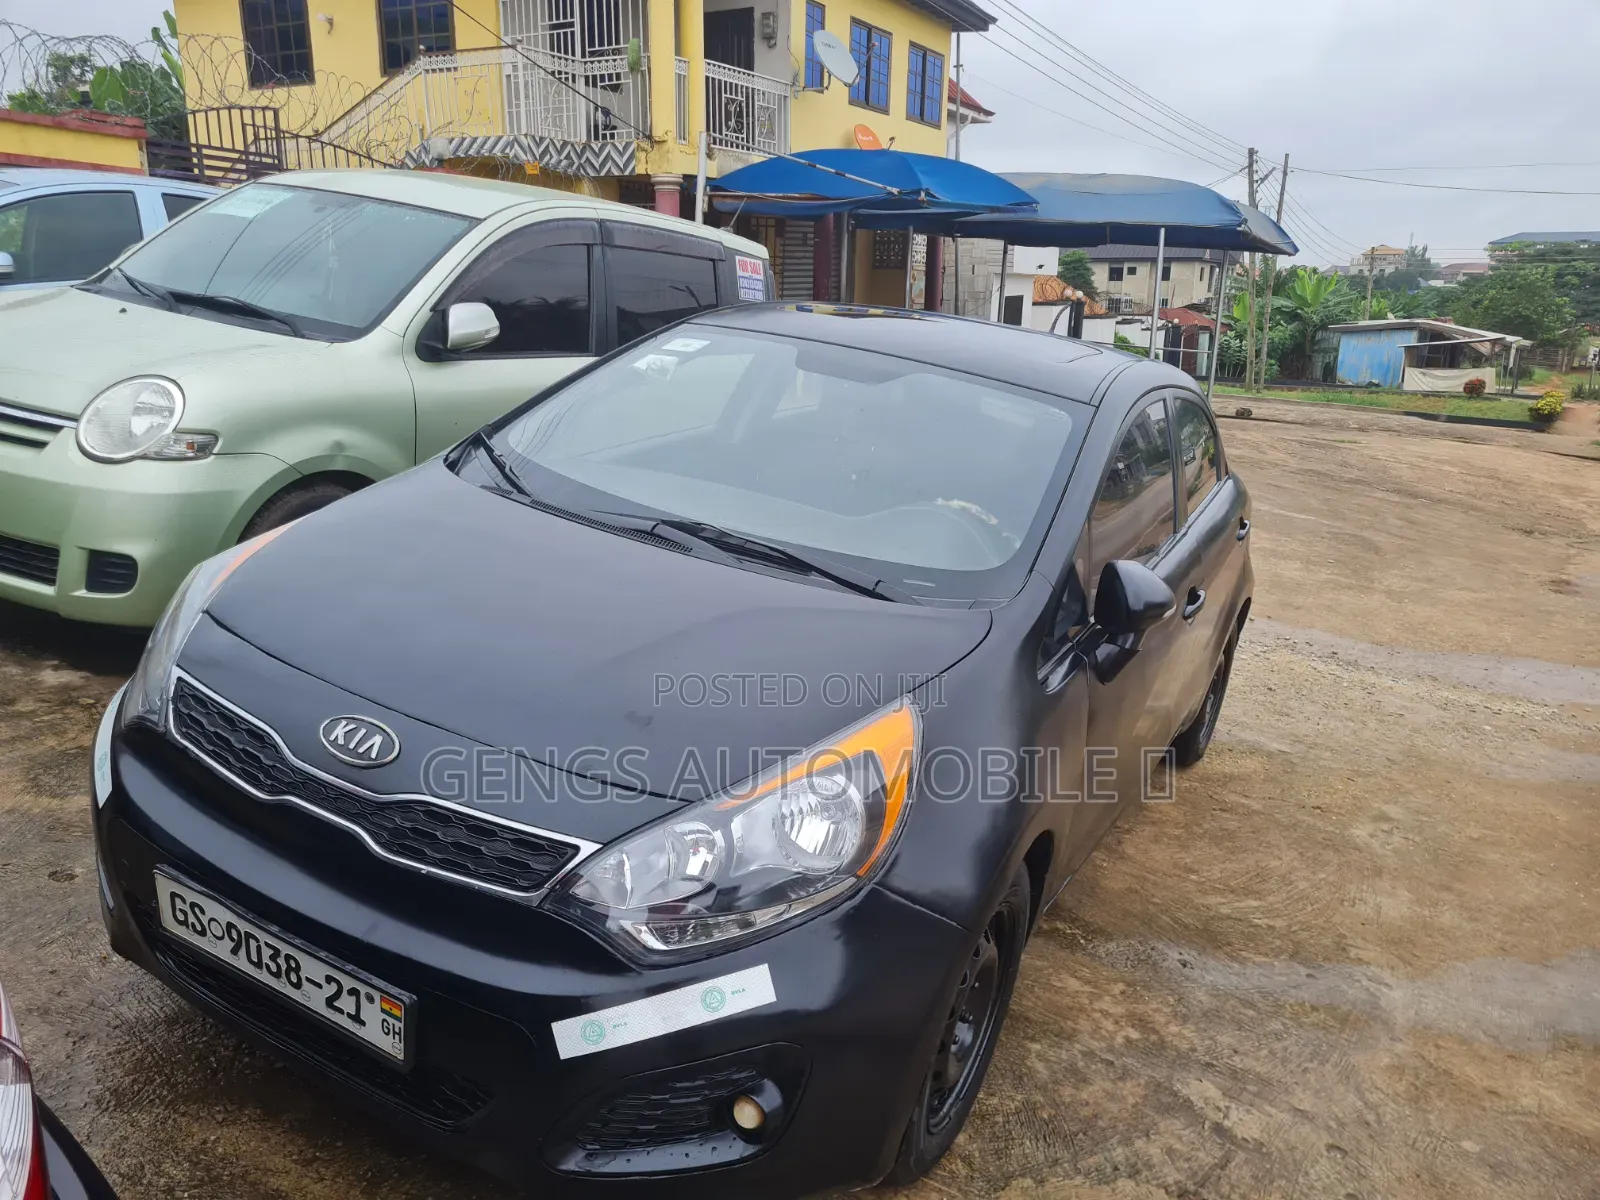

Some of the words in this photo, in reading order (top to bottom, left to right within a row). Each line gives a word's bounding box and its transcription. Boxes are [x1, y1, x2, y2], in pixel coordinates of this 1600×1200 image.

[738, 259, 749, 273] FOR
[749, 261, 761, 275] SALE
[328, 719, 384, 760] KIA
[169, 890, 208, 938] GS
[380, 1017, 402, 1044] GH
